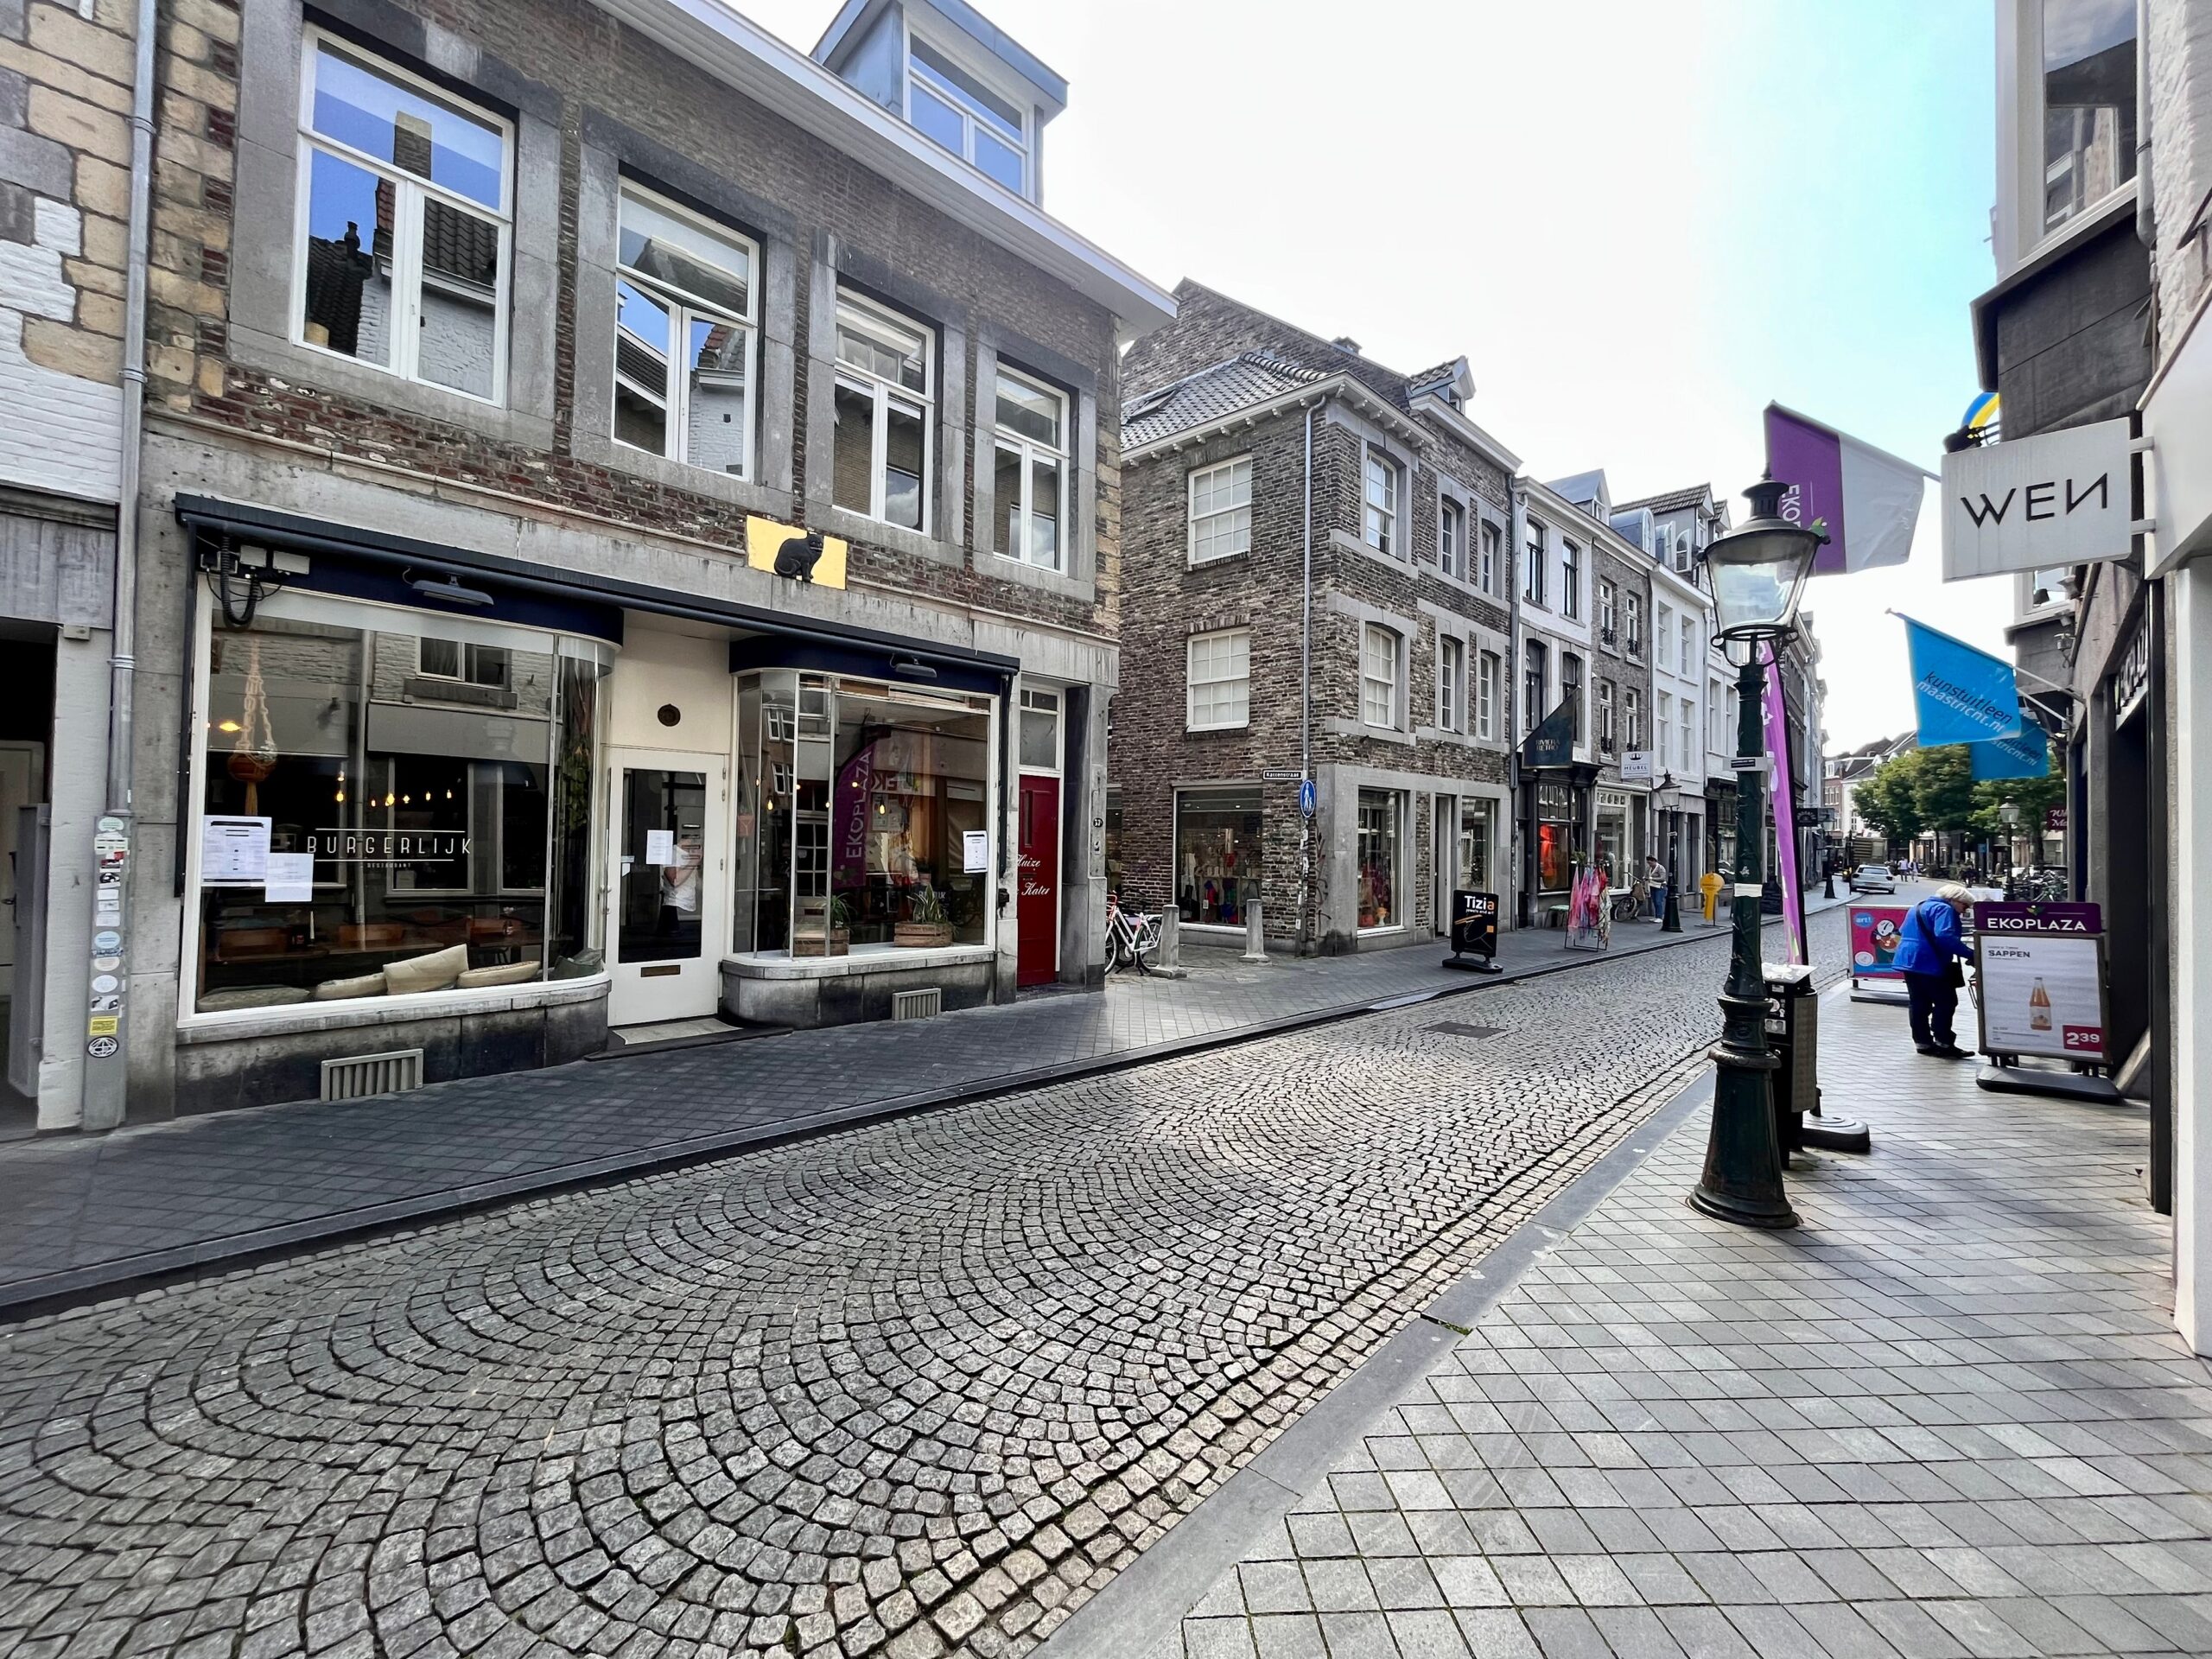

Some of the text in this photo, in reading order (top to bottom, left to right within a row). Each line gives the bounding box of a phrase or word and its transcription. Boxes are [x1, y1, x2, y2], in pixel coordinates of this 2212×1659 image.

[1923, 671, 2012, 724] kunstuitleen
[846, 751, 871, 858] EKOPLAZA
[307, 836, 472, 854] BURGERLIJK
[1016, 854, 1041, 868] Huize
[1021, 882, 1050, 896] Kater
[1464, 895, 1495, 910] Tizia
[1987, 918, 2087, 931] EKOPLAZA
